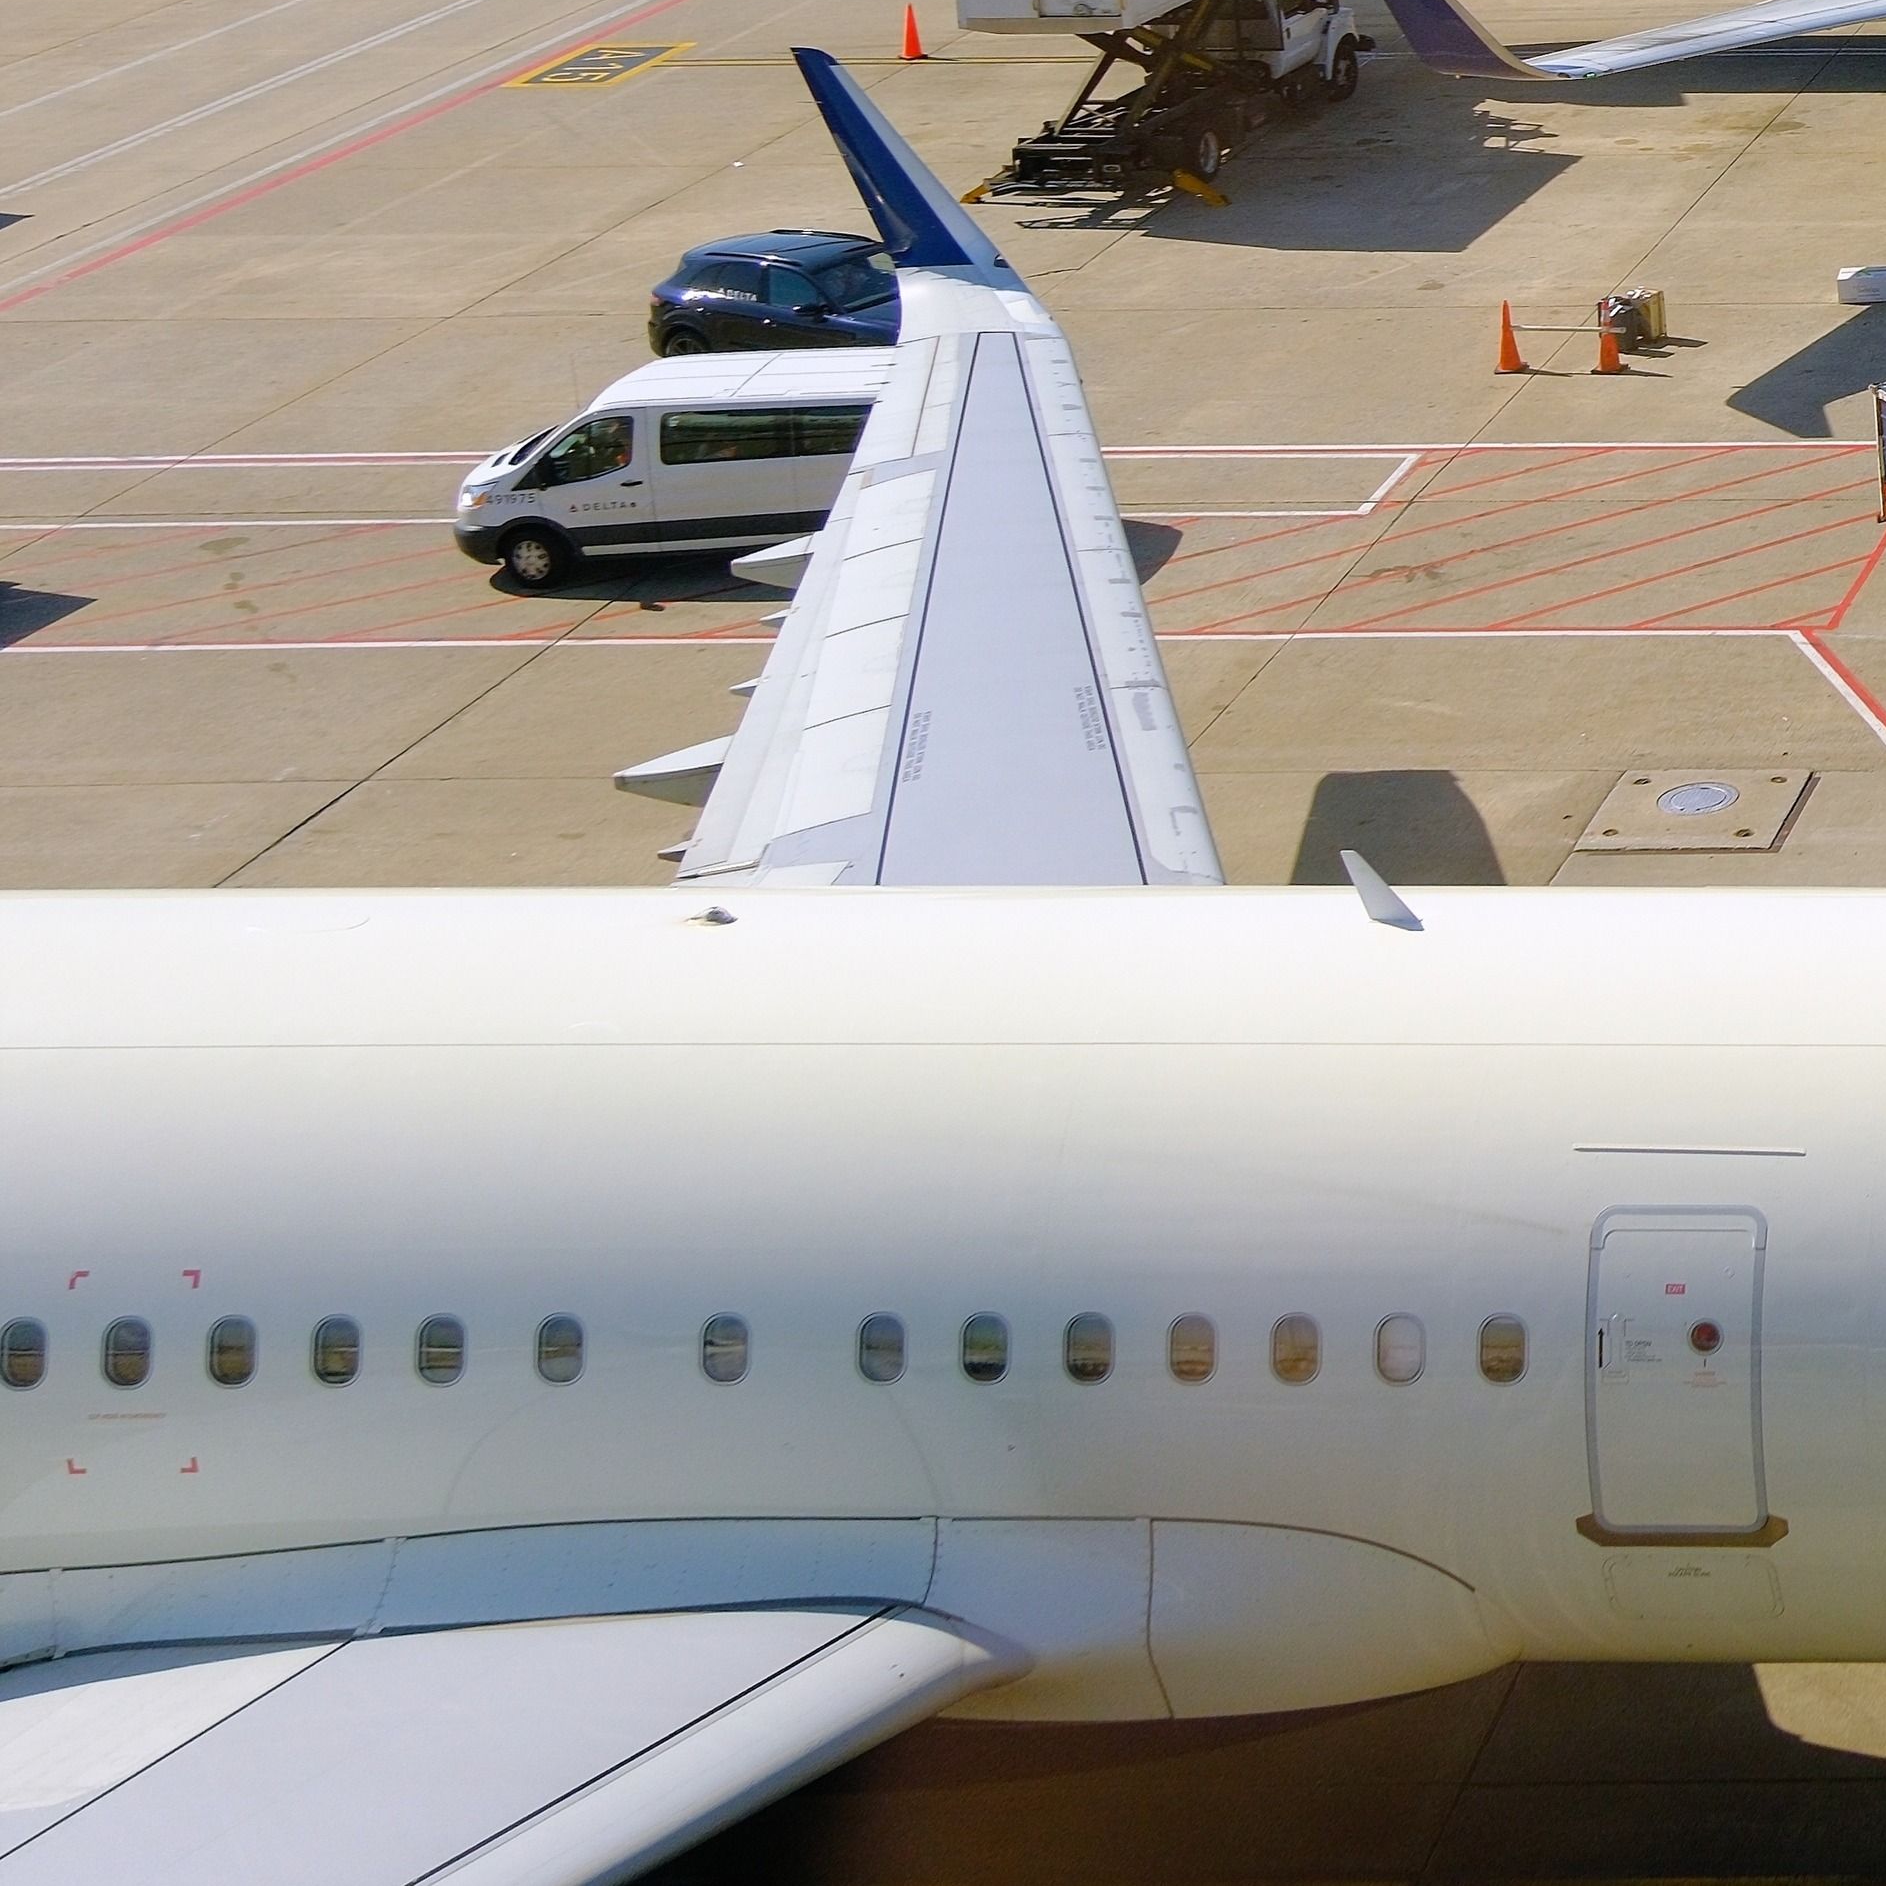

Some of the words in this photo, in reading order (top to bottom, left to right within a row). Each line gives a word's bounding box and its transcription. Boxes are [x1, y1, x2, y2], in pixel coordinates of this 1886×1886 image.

[541, 48, 647, 84] A15
[726, 288, 758, 302] DELTA
[487, 493, 537, 505] 491975
[584, 501, 629, 513] DELTA
